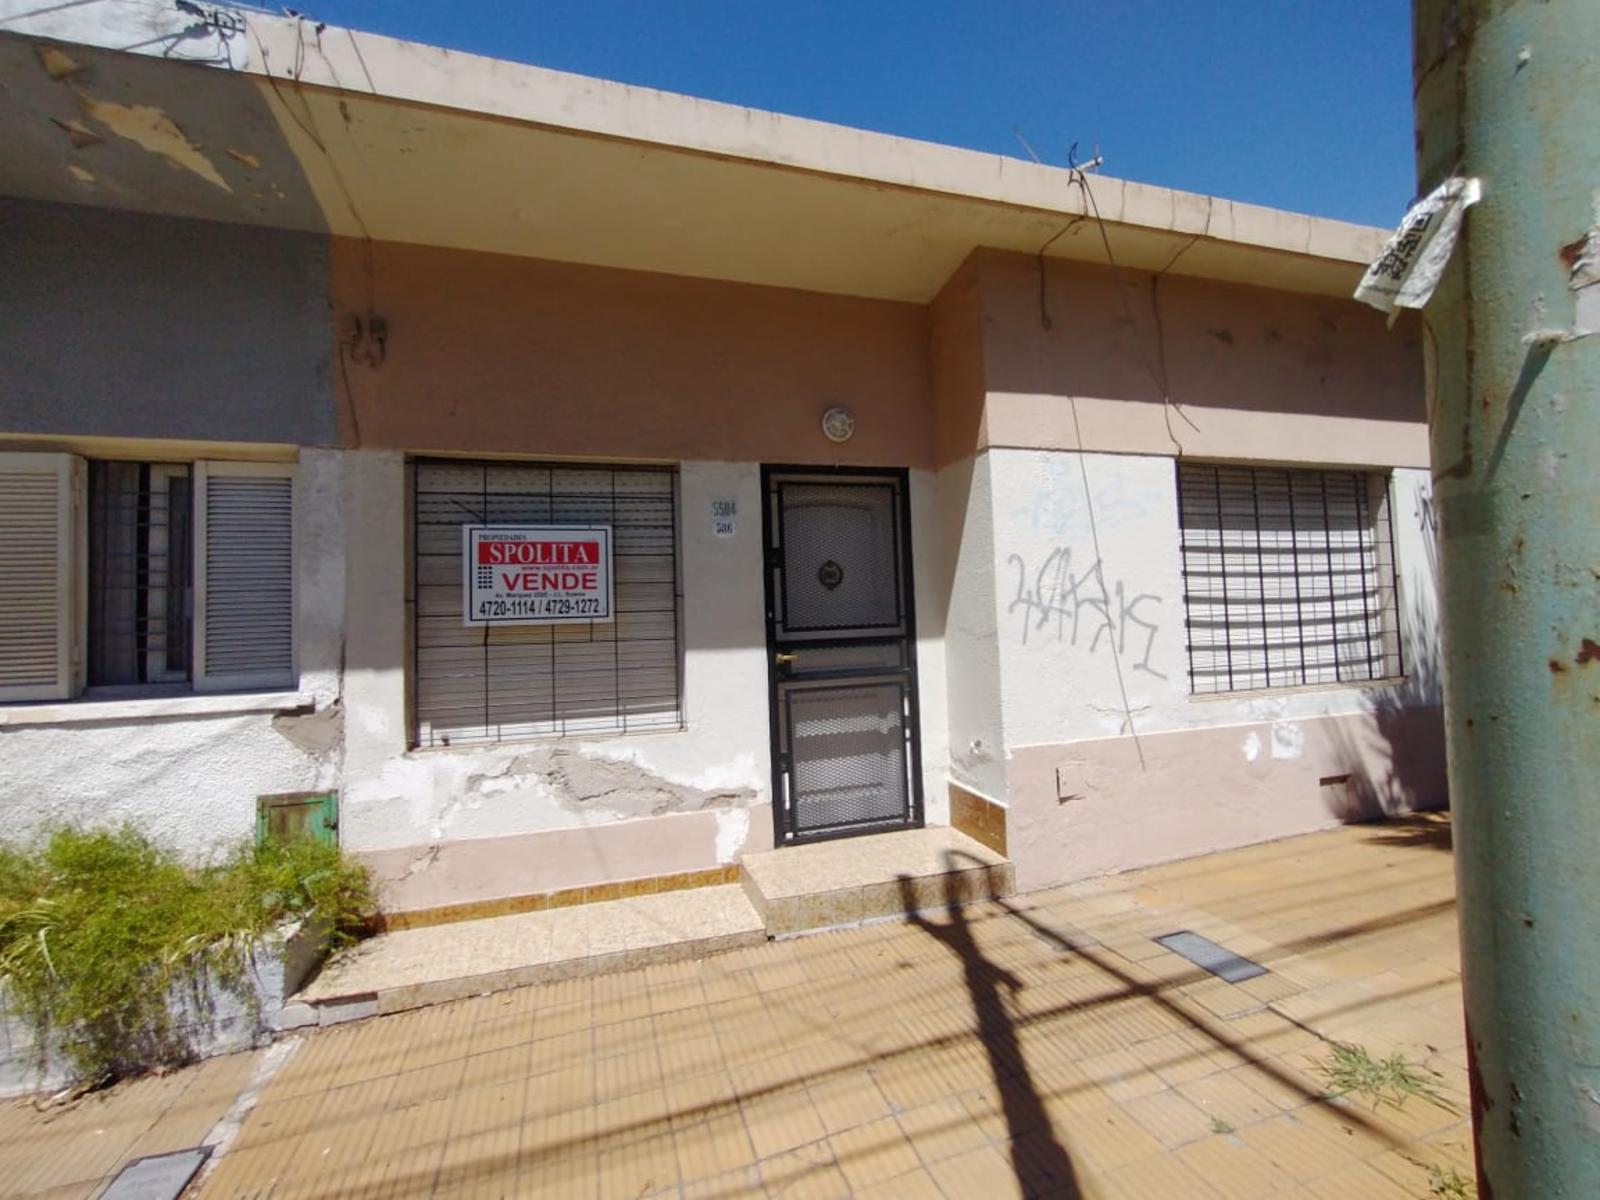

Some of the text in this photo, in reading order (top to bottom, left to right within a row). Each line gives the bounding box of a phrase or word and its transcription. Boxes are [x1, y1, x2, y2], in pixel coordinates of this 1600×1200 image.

[489, 542, 590, 564] SPOLITA
[502, 572, 598, 591] VENDE
[479, 598, 600, 616] 4720-1114 / 4729-1272
